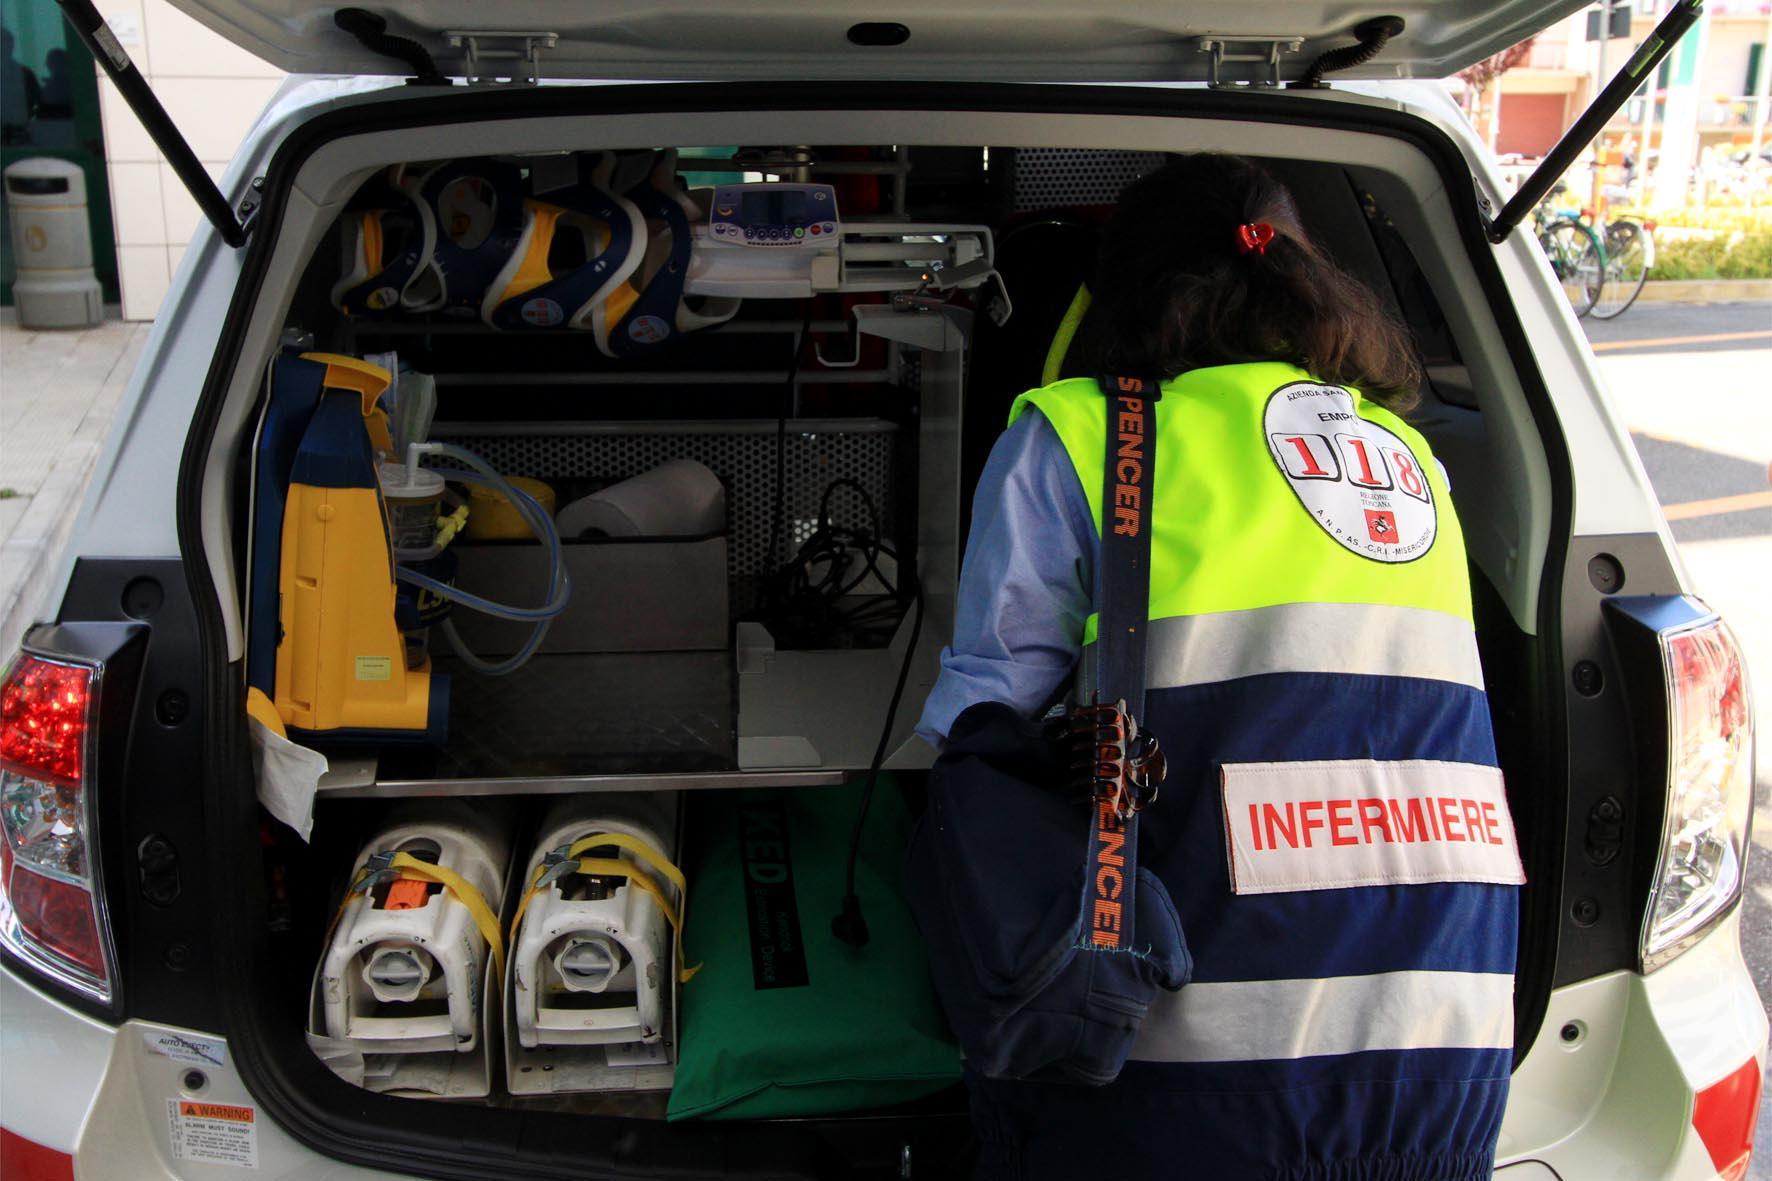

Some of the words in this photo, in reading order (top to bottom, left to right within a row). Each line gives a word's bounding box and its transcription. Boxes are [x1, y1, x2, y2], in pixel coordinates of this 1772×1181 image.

[1286, 389, 1321, 402] AZIENDA
[1113, 375, 1145, 538] SPENCER
[1360, 491, 1390, 501] REGIONE
[1361, 499, 1392, 508] TOSCANA
[1248, 796, 1504, 851] INFERMIERE
[743, 808, 788, 885] KED
[158, 1037, 179, 1047] AUTO
[199, 1104, 250, 1121] WARNING
[185, 1121, 206, 1130] ALARM
[208, 1123, 225, 1132] MUST
[228, 1125, 250, 1135] SOUND!
